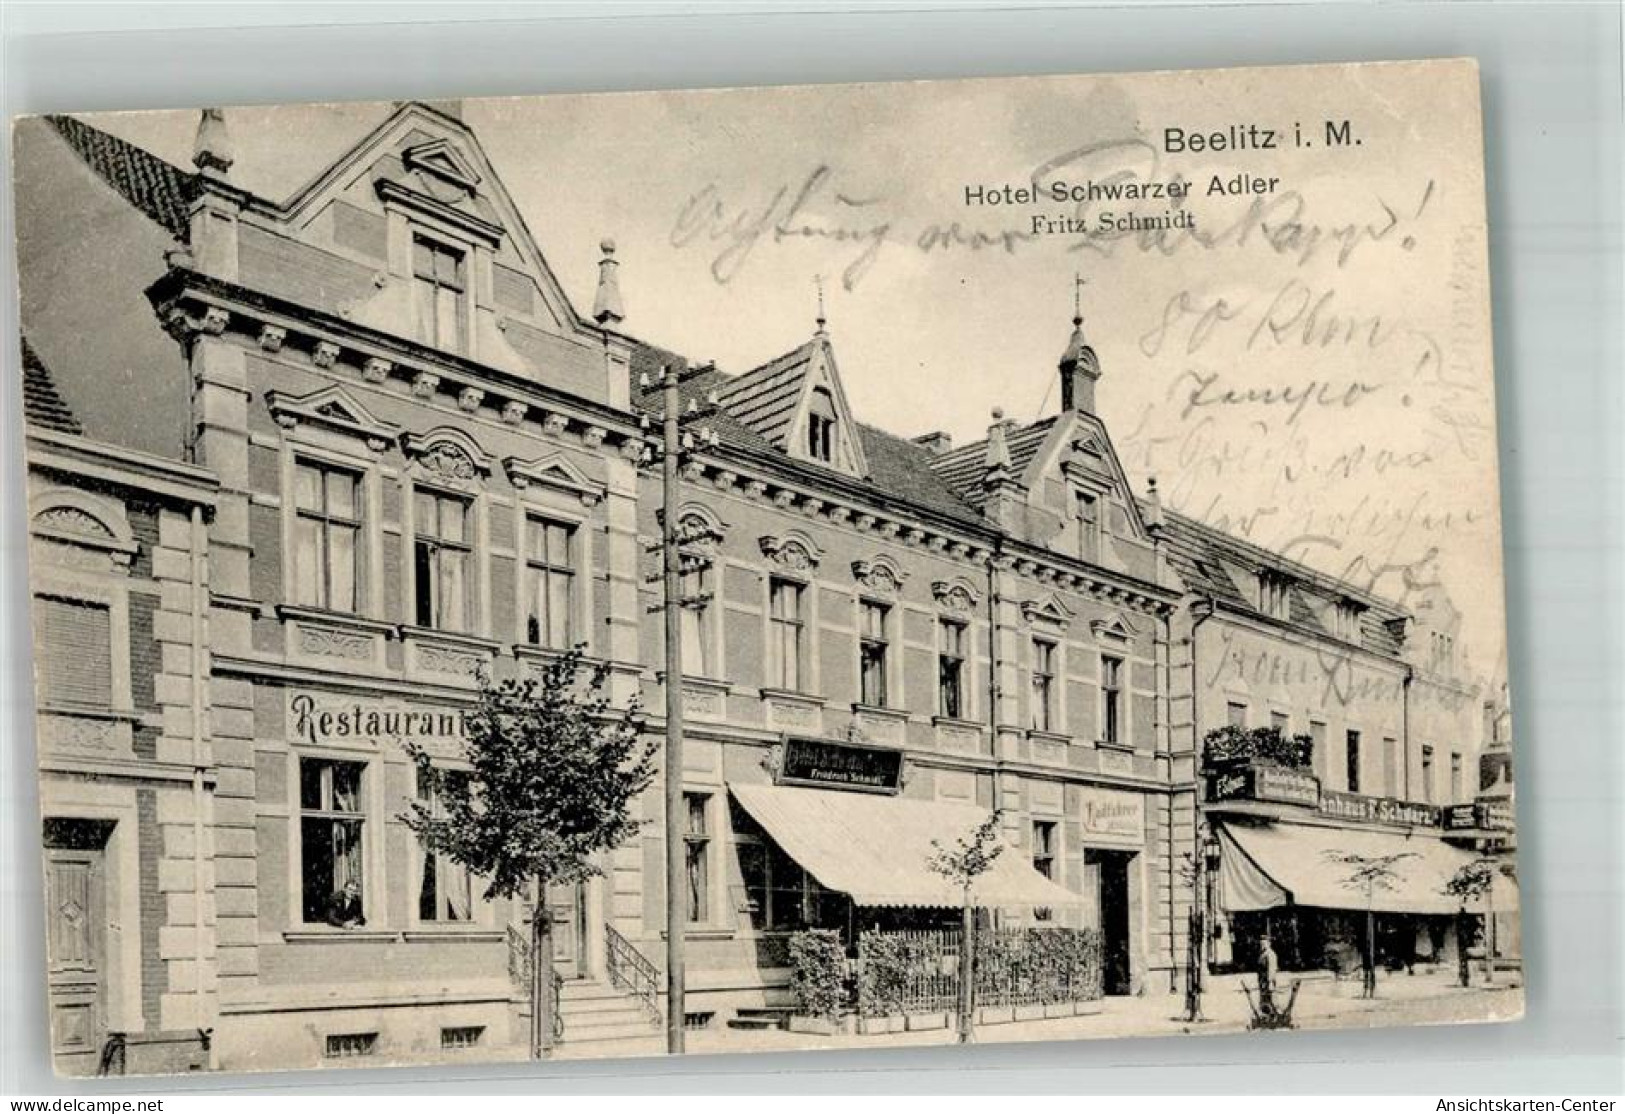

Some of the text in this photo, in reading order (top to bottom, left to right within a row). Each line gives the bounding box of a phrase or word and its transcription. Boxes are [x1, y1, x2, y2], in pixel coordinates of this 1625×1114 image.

[1164, 120, 1363, 154] Beelitz i. M.
[965, 173, 1280, 206] Hotel Schwarzer Adler
[1031, 210, 1197, 236] Fritz Schmidt
[290, 694, 467, 744] Restaurant
